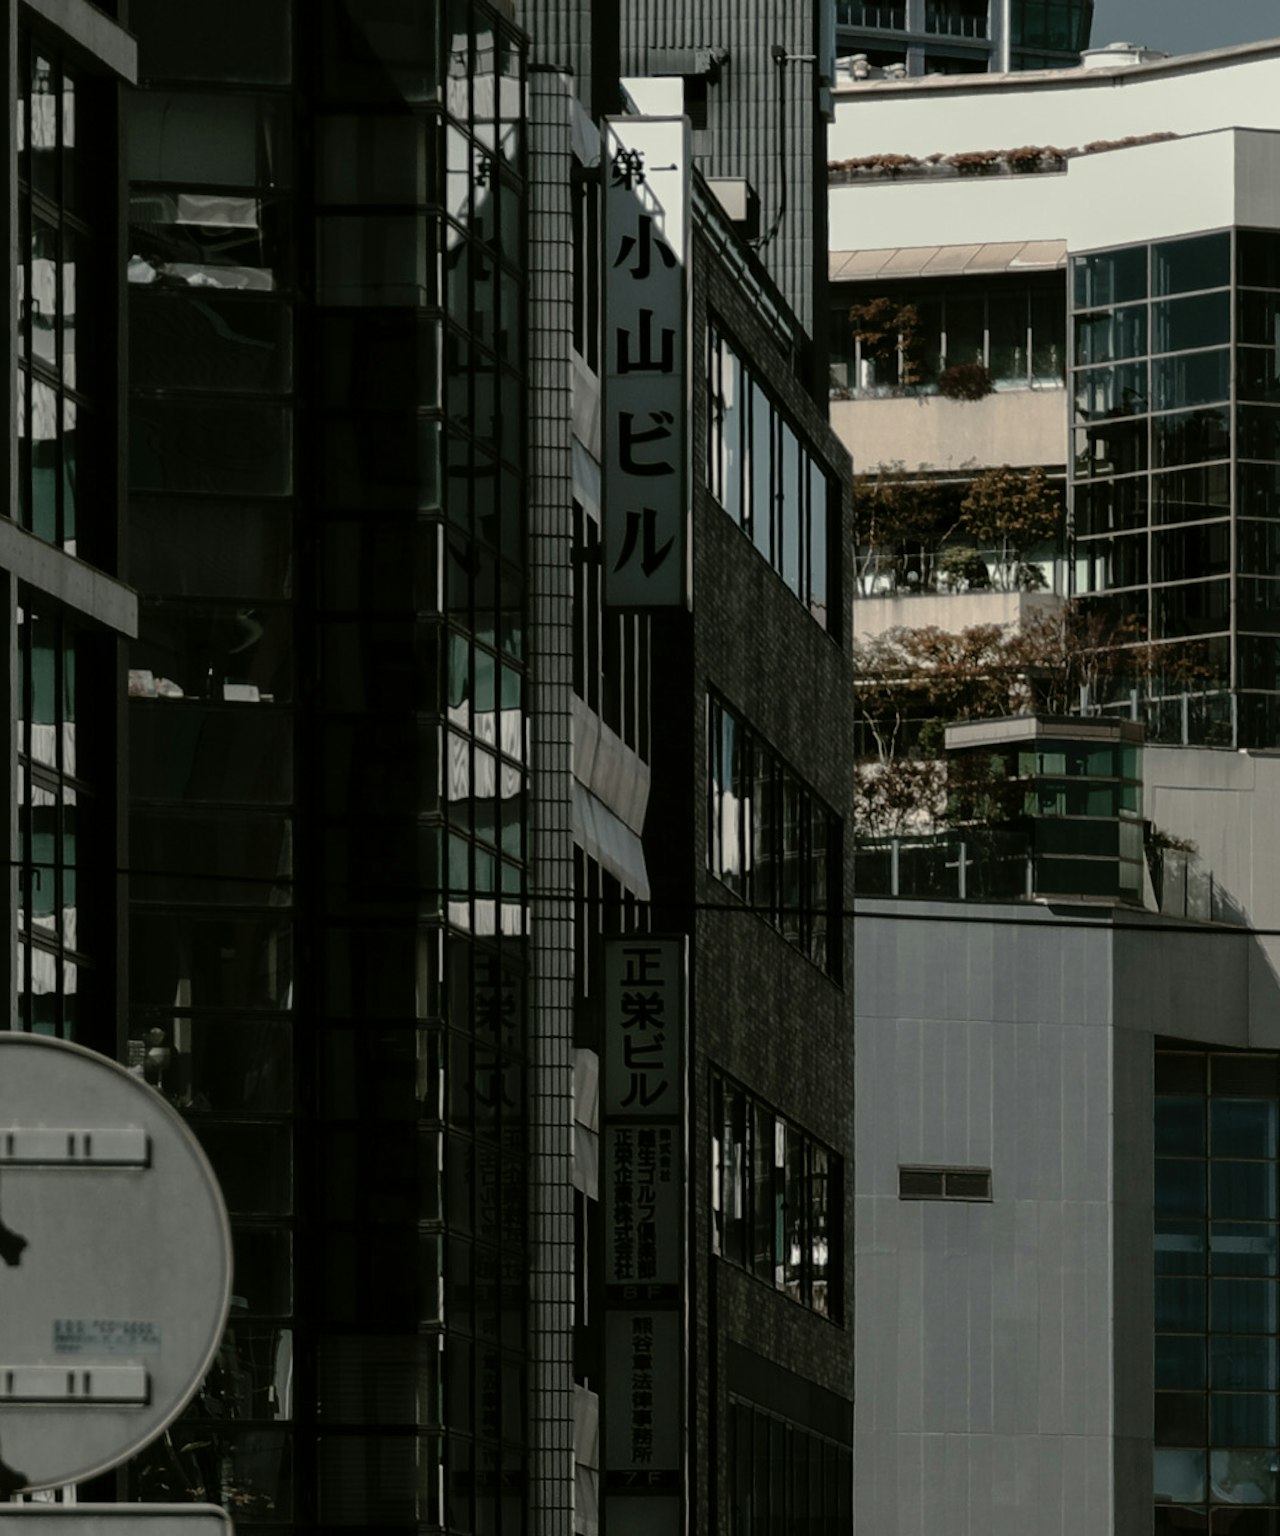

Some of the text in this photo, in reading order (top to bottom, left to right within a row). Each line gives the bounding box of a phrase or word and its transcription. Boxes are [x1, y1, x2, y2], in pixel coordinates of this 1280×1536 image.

[610, 147, 680, 192] 第一
[613, 214, 676, 578] 小山ビル
[620, 948, 667, 1108] 正栄ビル
